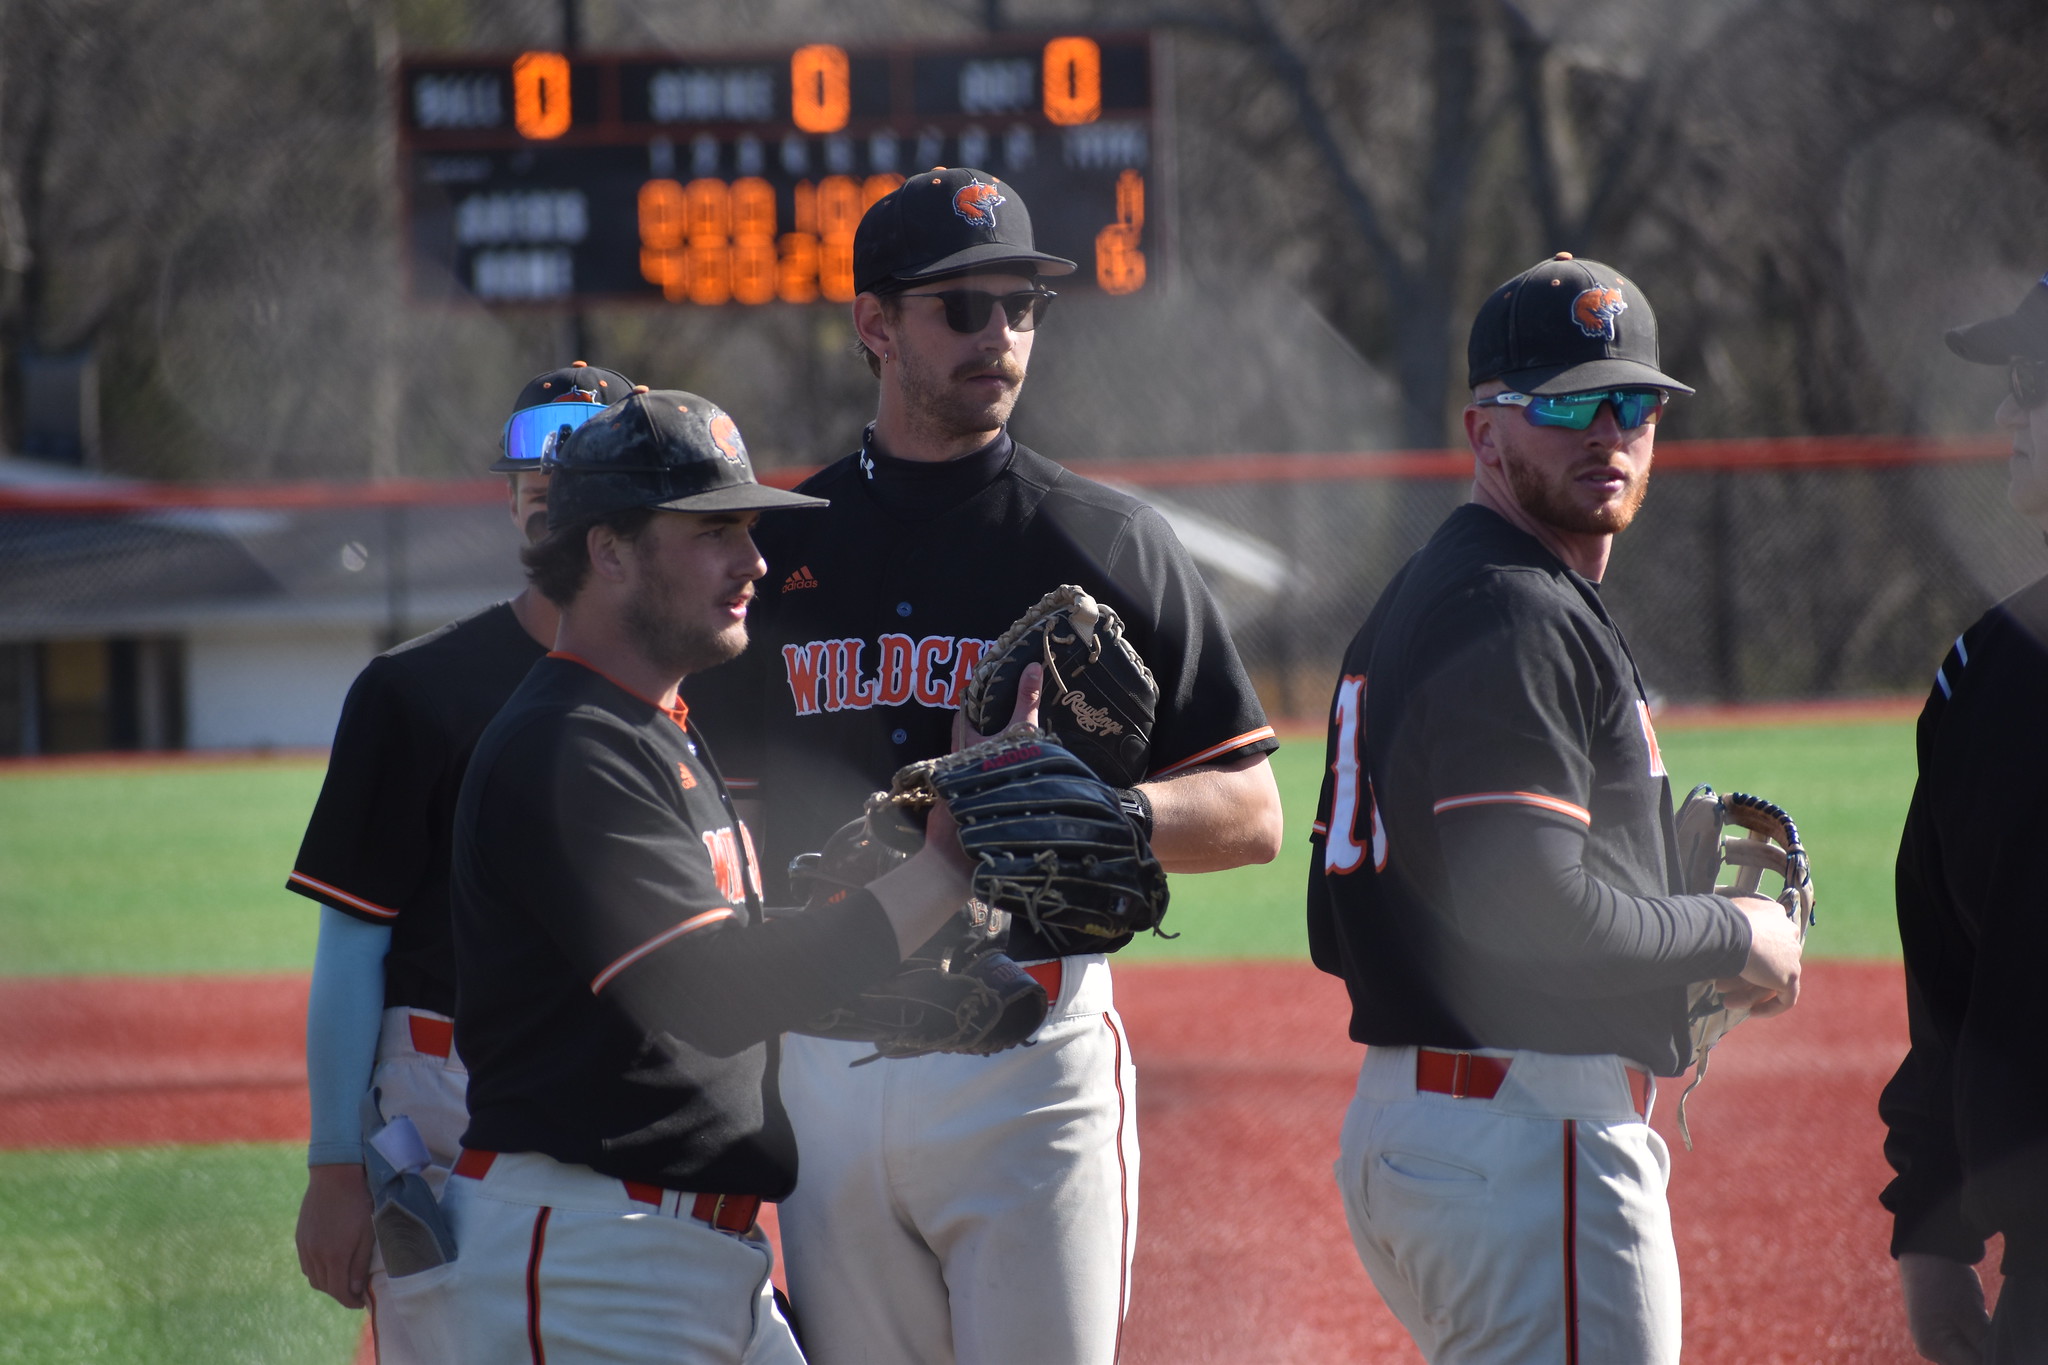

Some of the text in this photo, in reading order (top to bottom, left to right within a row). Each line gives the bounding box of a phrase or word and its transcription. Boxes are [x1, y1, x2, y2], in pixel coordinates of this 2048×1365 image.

[513, 52, 571, 139] 0
[791, 44, 850, 132] 0
[1042, 37, 1101, 125] 0
[782, 579, 819, 594] adidas
[782, 633, 1000, 716] WILDCA
[1061, 690, 1124, 736] Rawlings
